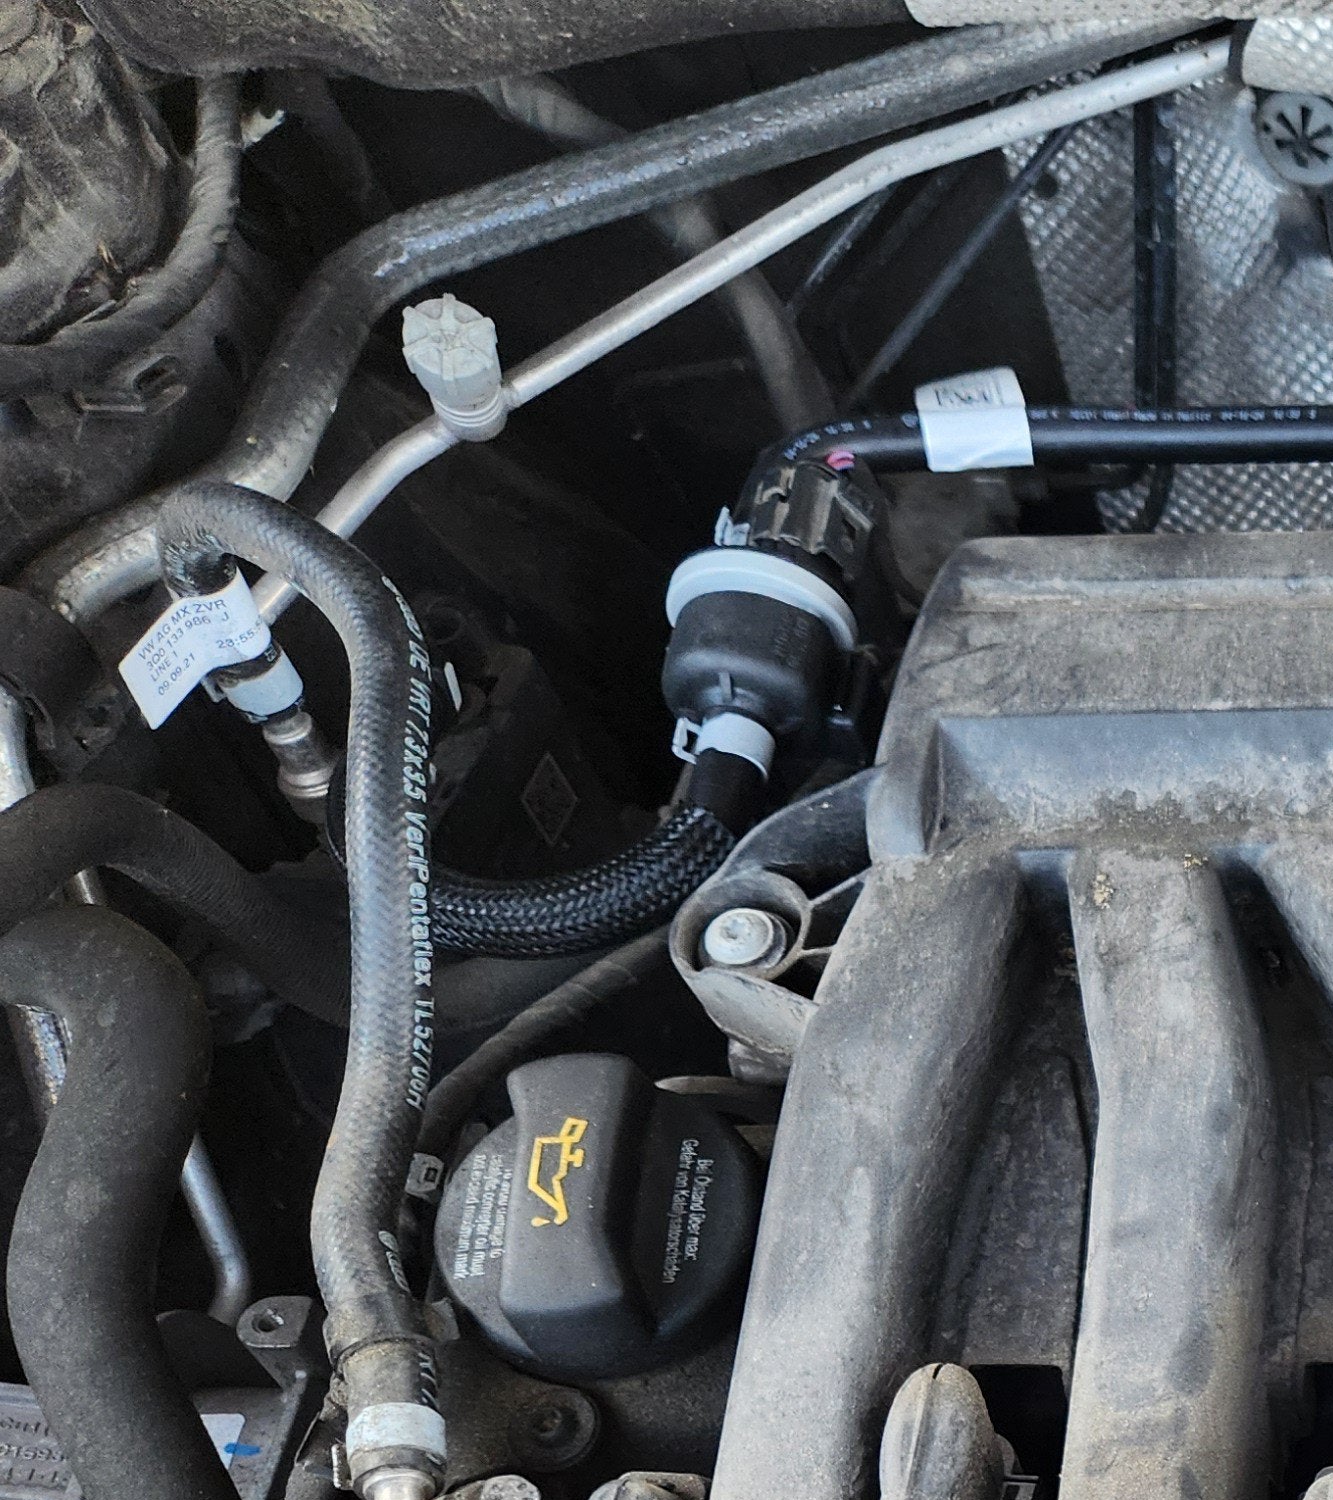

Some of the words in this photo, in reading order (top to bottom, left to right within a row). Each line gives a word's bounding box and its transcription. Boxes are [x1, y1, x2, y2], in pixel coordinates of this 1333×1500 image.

[138, 638, 158, 661] VW
[156, 623, 172, 643] AG
[170, 606, 194, 625] MX
[167, 628, 185, 648] 133
[185, 615, 212, 631] 986
[220, 611, 231, 623] J
[150, 658, 173, 683] LINE
[157, 652, 197, 696] 09.09.21
[679, 1138, 701, 1170] Gefahr
[674, 1170, 690, 1188] von
